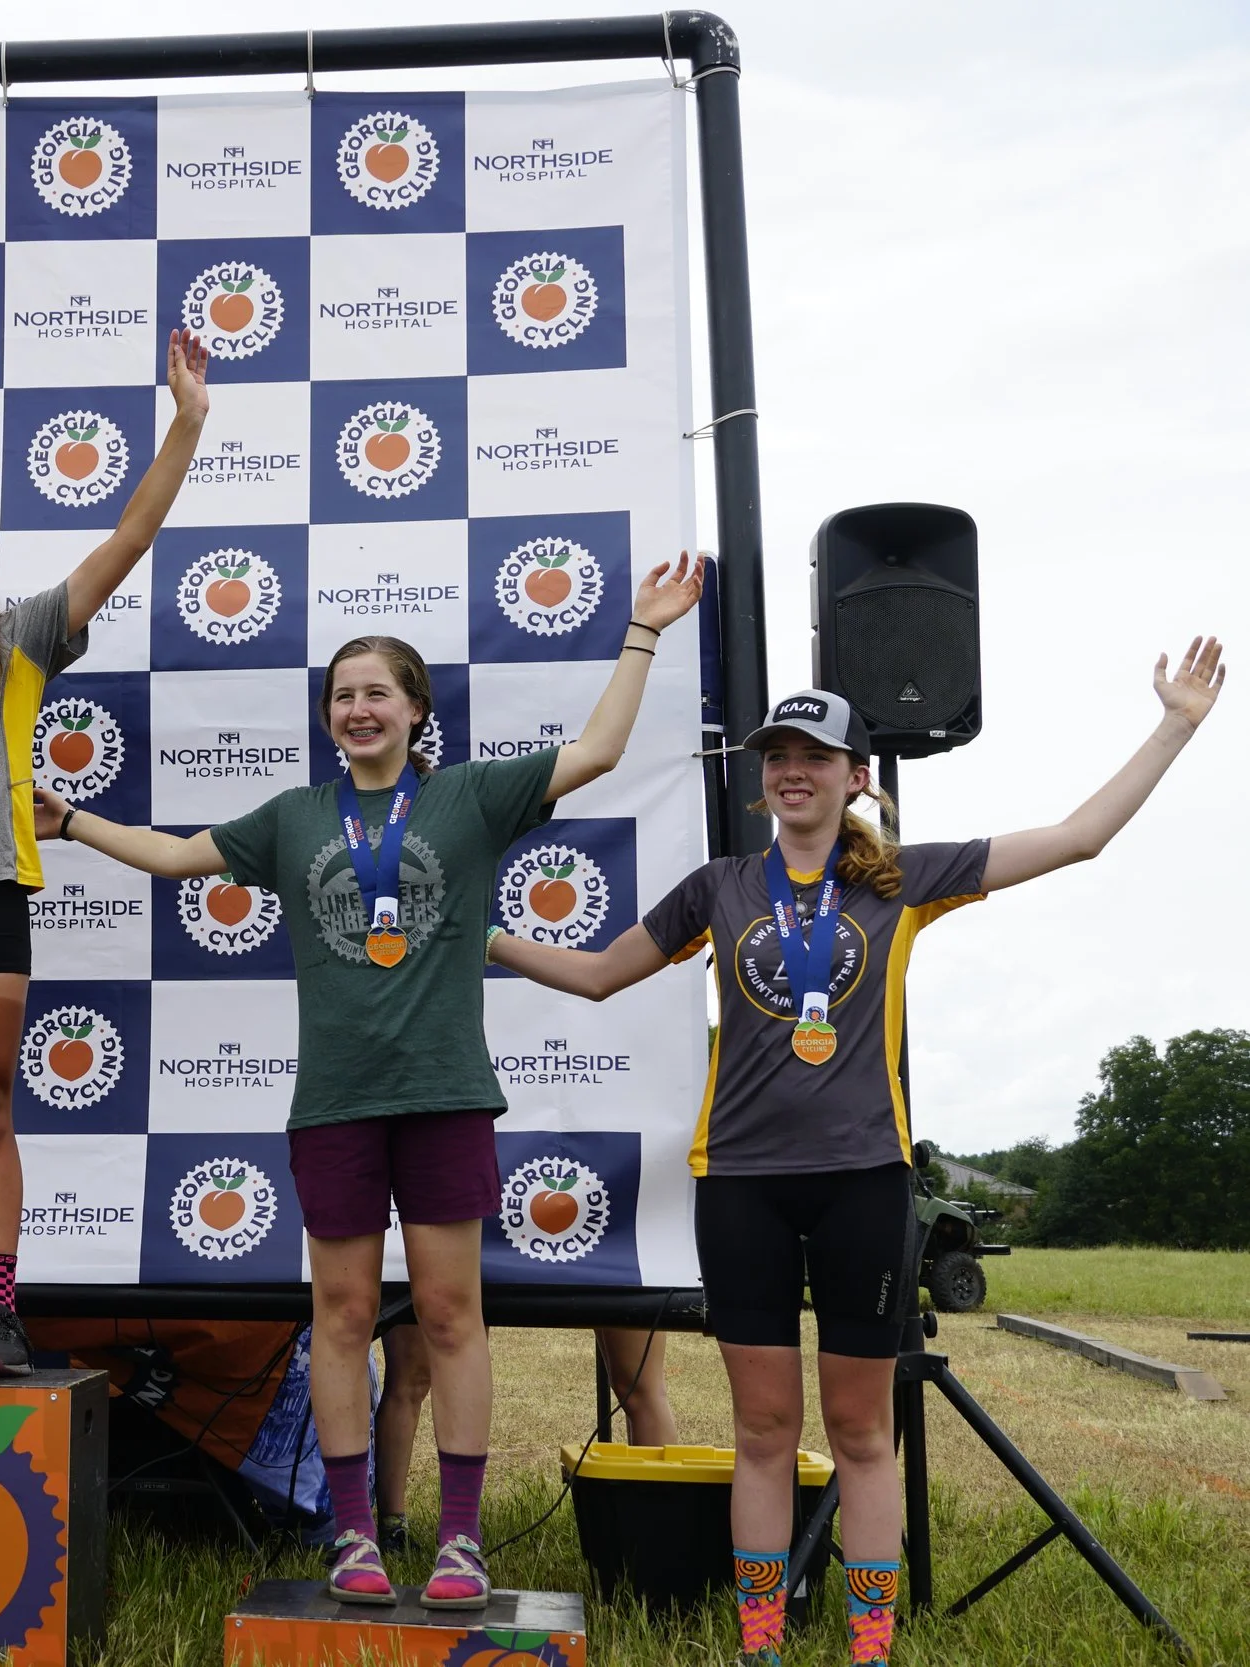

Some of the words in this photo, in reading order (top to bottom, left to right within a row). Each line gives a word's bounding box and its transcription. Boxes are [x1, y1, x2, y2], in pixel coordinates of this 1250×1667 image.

[38, 123, 102, 185] GEORGIA
[344, 118, 409, 178] GEORGIA
[475, 149, 612, 170] NORTHSIDE
[61, 147, 125, 209] CYCLING
[167, 161, 301, 177] NORTHSIDE
[192, 179, 276, 189] HOSPITAL
[367, 141, 433, 202] CYCLING
[500, 169, 586, 181] HOSPITAL
[189, 268, 253, 329] GEORGIA
[500, 259, 566, 319] GEORGIA
[14, 310, 147, 326] NORTHSIDE
[212, 291, 277, 352] CYCLING
[320, 301, 457, 318] NORTHSIDE
[346, 319, 431, 329] HOSPITAL
[524, 280, 591, 341] CYCLING
[39, 328, 122, 338] HOSPITAL
[35, 417, 100, 476] GEORGIA
[344, 408, 410, 468] GEORGIA
[477, 439, 618, 460] NORTHSIDE
[57, 439, 122, 499] CYCLING
[189, 473, 275, 483] HOSPITAL
[367, 430, 434, 491] CYCLING
[503, 458, 592, 471] HOSPITAL
[184, 555, 249, 613] GEORGIA
[503, 543, 571, 604] GEORGIA
[207, 577, 274, 637] CYCLING
[318, 586, 459, 603] NORTHSIDE
[344, 604, 432, 614] HOSPITAL
[527, 565, 597, 628] CYCLING
[779, 702, 821, 716] KASK
[33, 704, 94, 769] GEORGIA
[52, 729, 118, 794] CYCLING
[161, 748, 299, 765] NORTHSIDE
[186, 767, 273, 777] HOSPITAL
[389, 792, 405, 824] GEORGIA
[344, 815, 359, 849] GEORGIA
[507, 852, 574, 918] GEORGIA
[819, 879, 834, 917] GEORGIA
[29, 901, 142, 916] ORTHSIDE
[31, 919, 118, 929] HOSPITAL
[532, 877, 602, 944] CYCLING
[774, 900, 789, 938] GEORGIA
[745, 958, 793, 1008] MOUNTAIN
[836, 948, 857, 983] TEAM
[28, 1012, 93, 1076] GEORGIA
[794, 1038, 835, 1046] GEORGIA
[50, 1037, 117, 1102] CYCLING
[160, 1060, 297, 1074] NORTHSIDE
[185, 1078, 273, 1087] HOSPITAL
[510, 1073, 602, 1084] HOSPITAL
[177, 1164, 247, 1227] GEORGIA
[507, 1164, 579, 1228] GEORGIA
[19, 1226, 107, 1235] HOSPITAL
[200, 1188, 270, 1252] CYCLING
[530, 1191, 603, 1255] CYCLING
[877, 1280, 890, 1315] CRAFT
